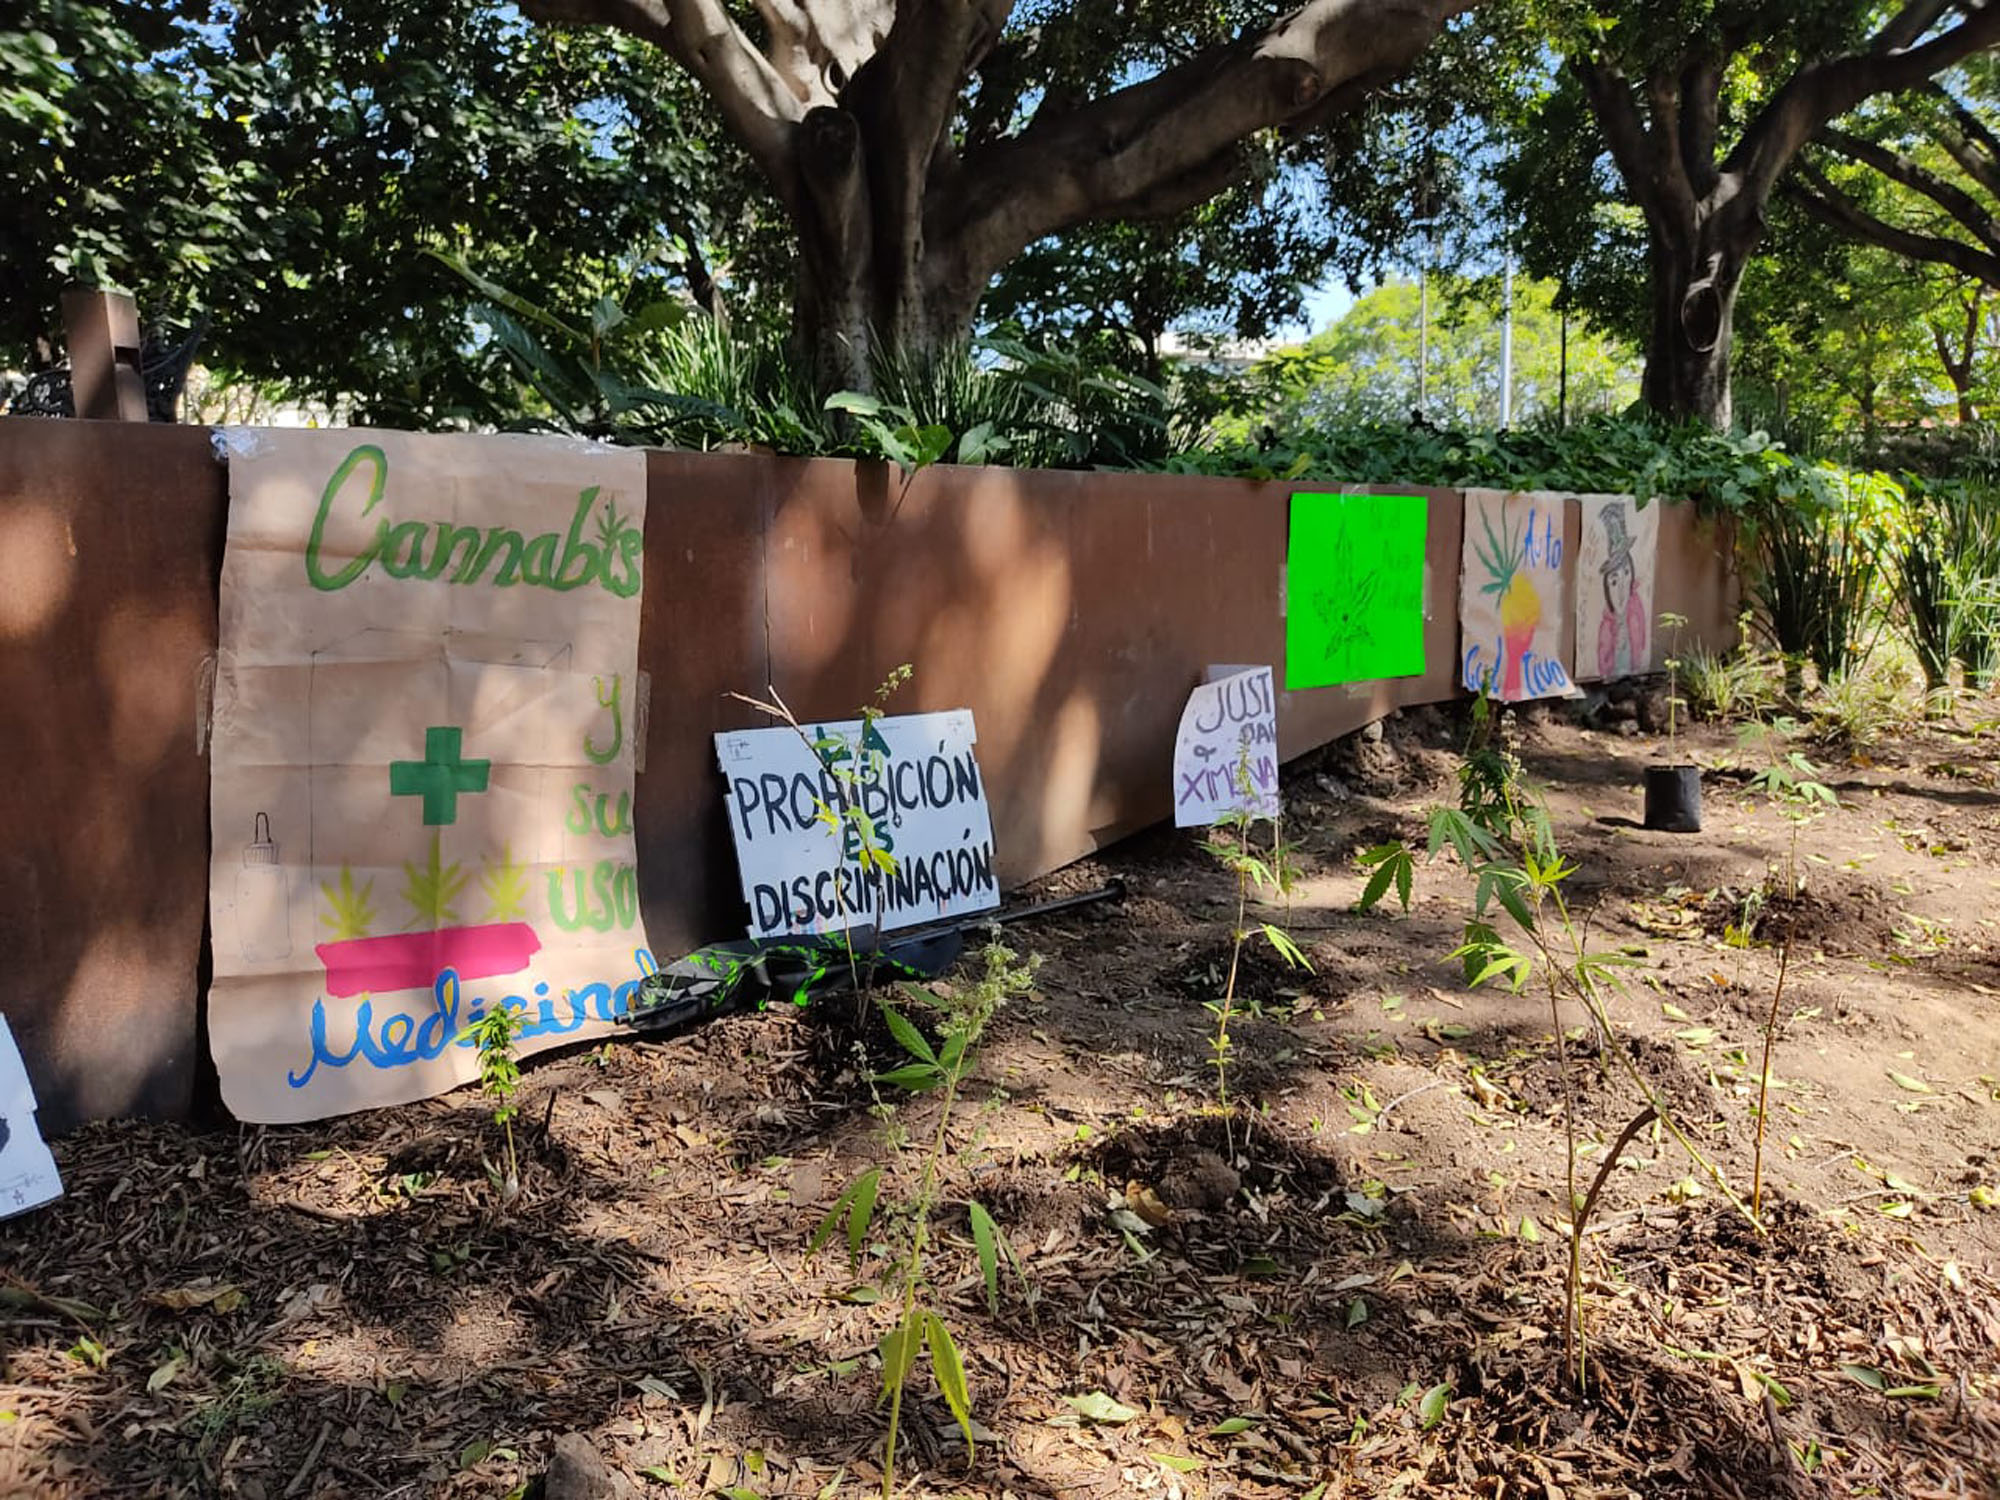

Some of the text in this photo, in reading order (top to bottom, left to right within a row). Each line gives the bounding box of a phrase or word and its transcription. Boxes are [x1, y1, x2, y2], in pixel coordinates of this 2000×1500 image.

[306, 444, 643, 599] Cannabis
[733, 739, 980, 841] PROHIBICIÓN
[816, 719, 891, 762] LA
[753, 828, 994, 933] DISCRIMINACIÓN
[843, 818, 895, 862] ES
